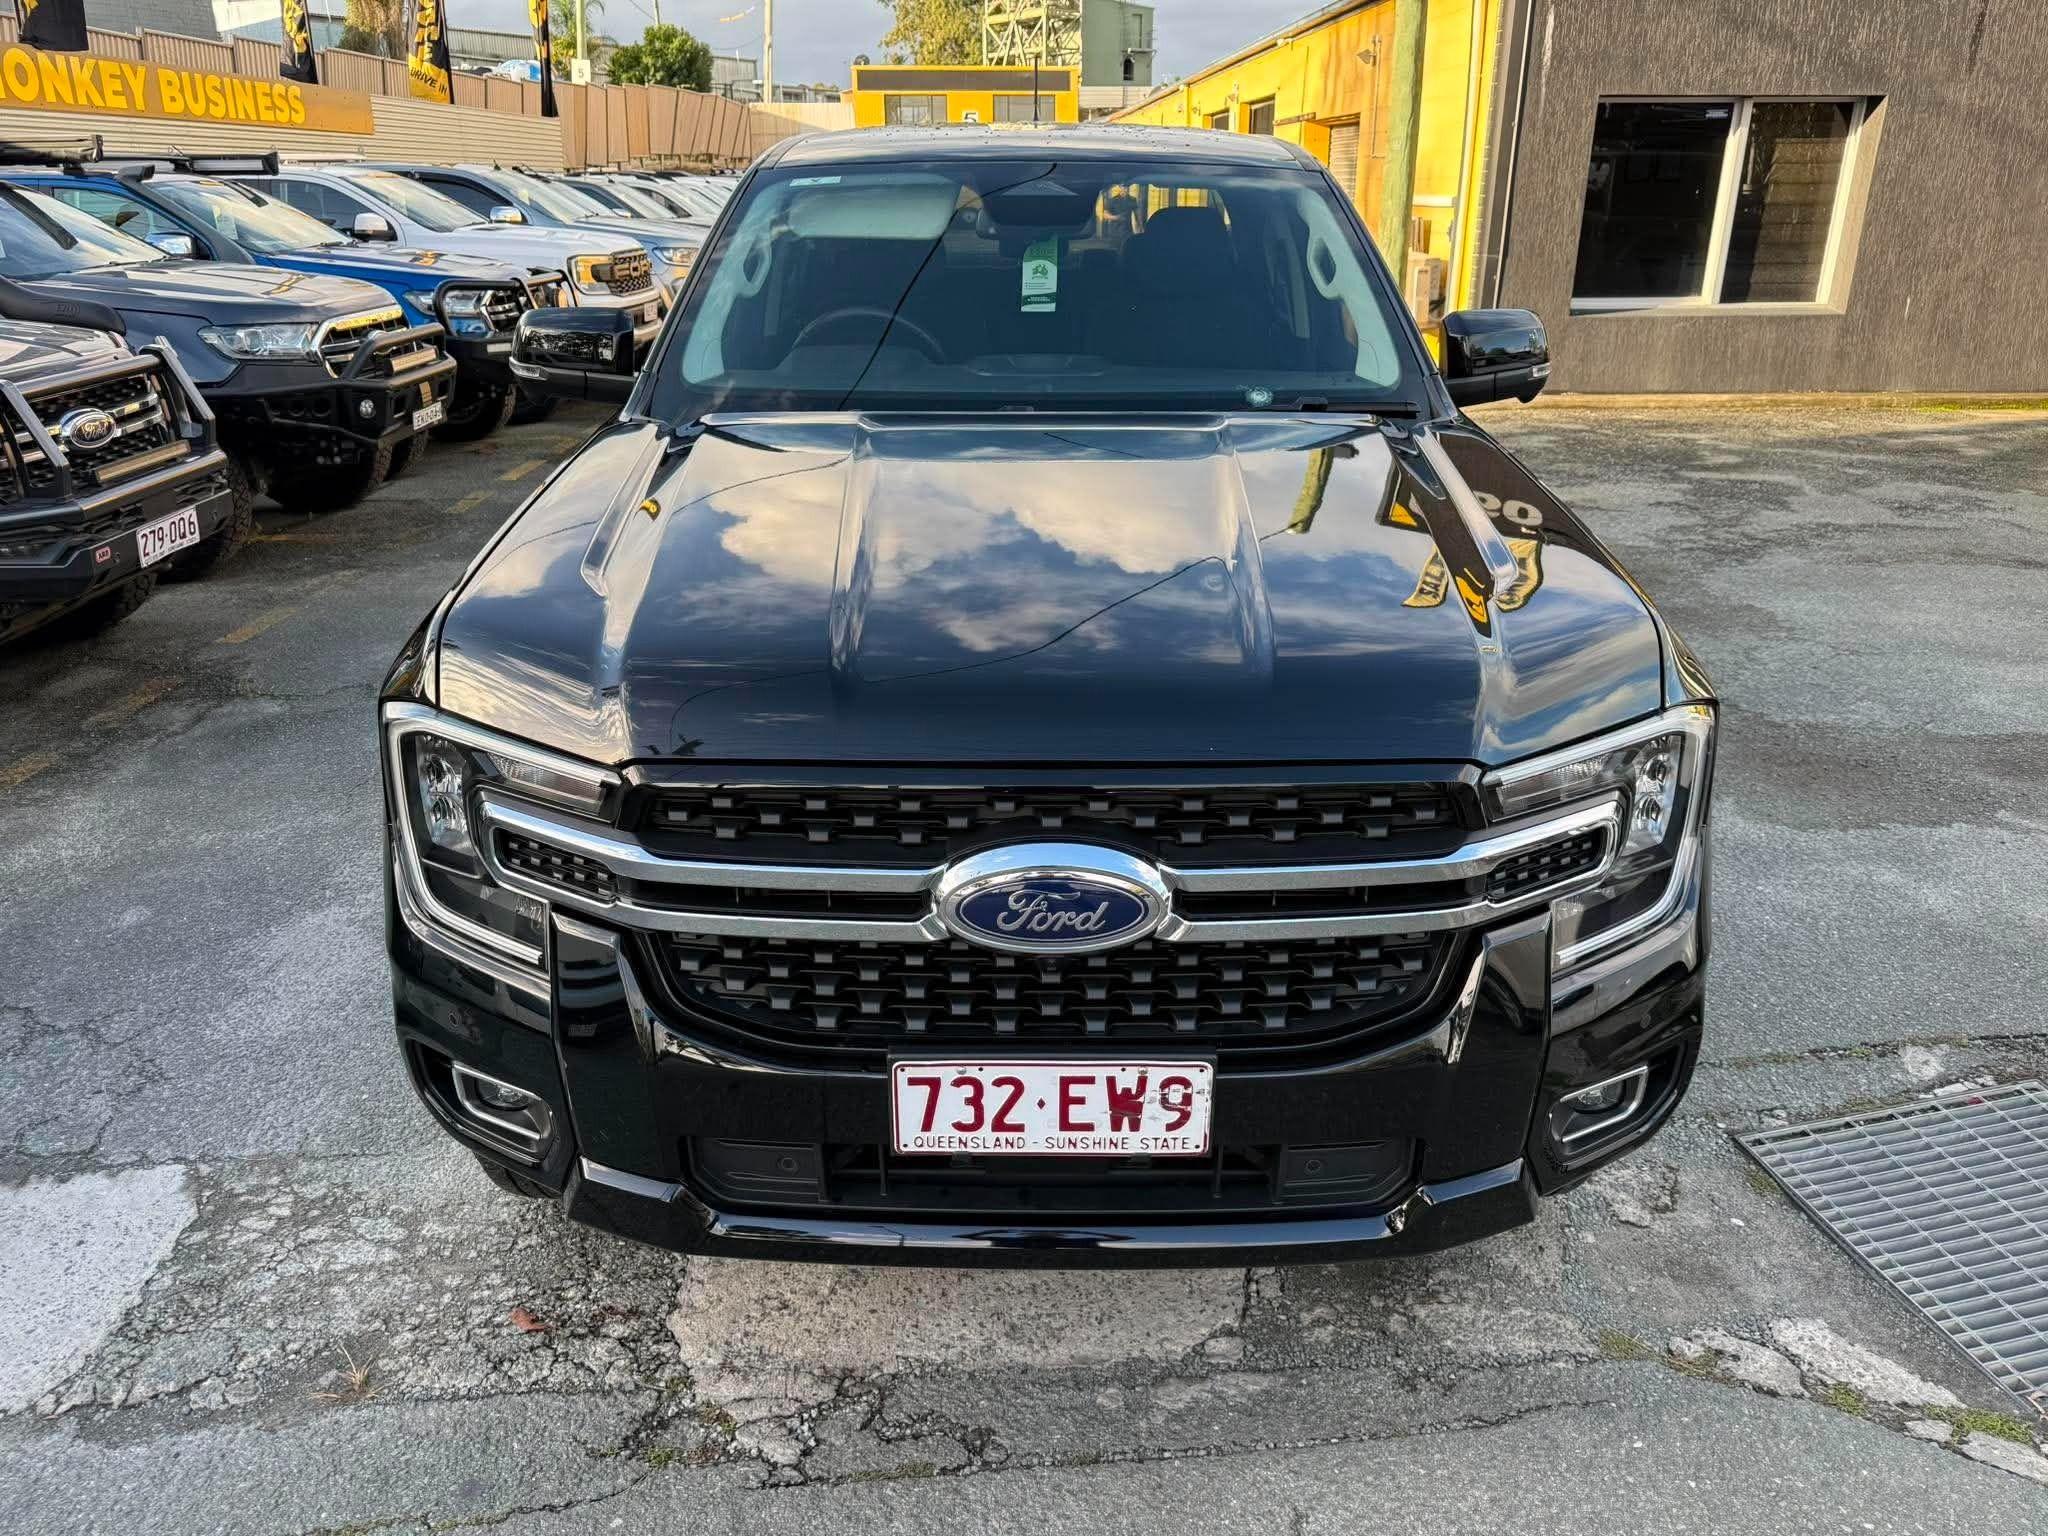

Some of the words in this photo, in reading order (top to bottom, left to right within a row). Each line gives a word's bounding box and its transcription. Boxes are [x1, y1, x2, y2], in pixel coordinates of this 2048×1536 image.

[0, 48, 146, 112] ONKEY
[158, 68, 306, 124] BUSINESS
[410, 67, 438, 88] DRIVE
[996, 888, 1109, 931] Ford
[914, 1136, 1026, 1149] QUEENSLAND
[1045, 1136, 1129, 1150] SUNSHINE
[1140, 1137, 1190, 1150] STATE
